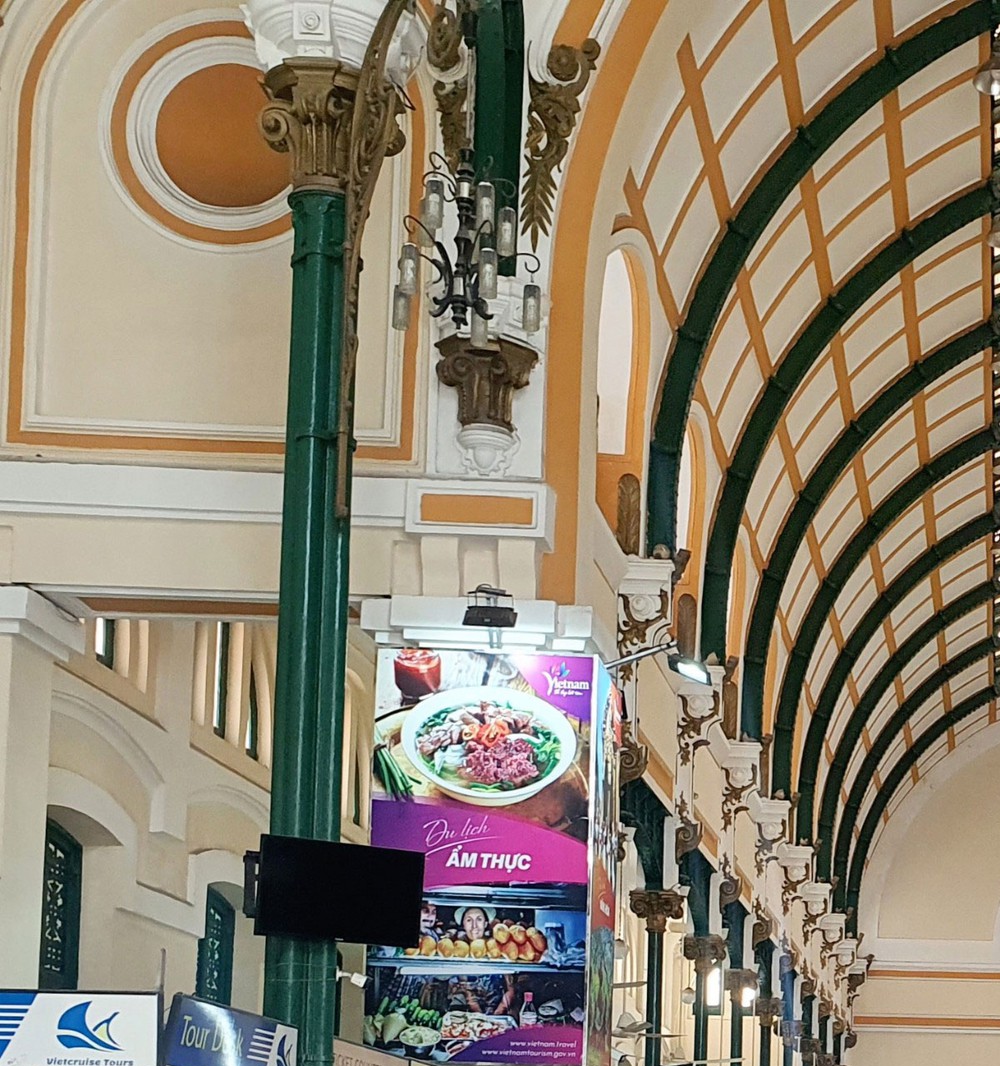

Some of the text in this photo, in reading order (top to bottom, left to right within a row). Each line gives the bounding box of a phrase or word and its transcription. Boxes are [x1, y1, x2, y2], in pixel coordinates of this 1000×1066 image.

[542, 671, 590, 696] Vietnam
[423, 815, 490, 847] Du lịch
[445, 844, 532, 873] ẨM THỰC
[180, 1015, 244, 1057] Tour Dk
[510, 1040, 577, 1048] www.vietnam.travel
[46, 1057, 100, 1066] Vietcruise
[482, 1049, 576, 1058] www.vietnamtourism.gov.vn
